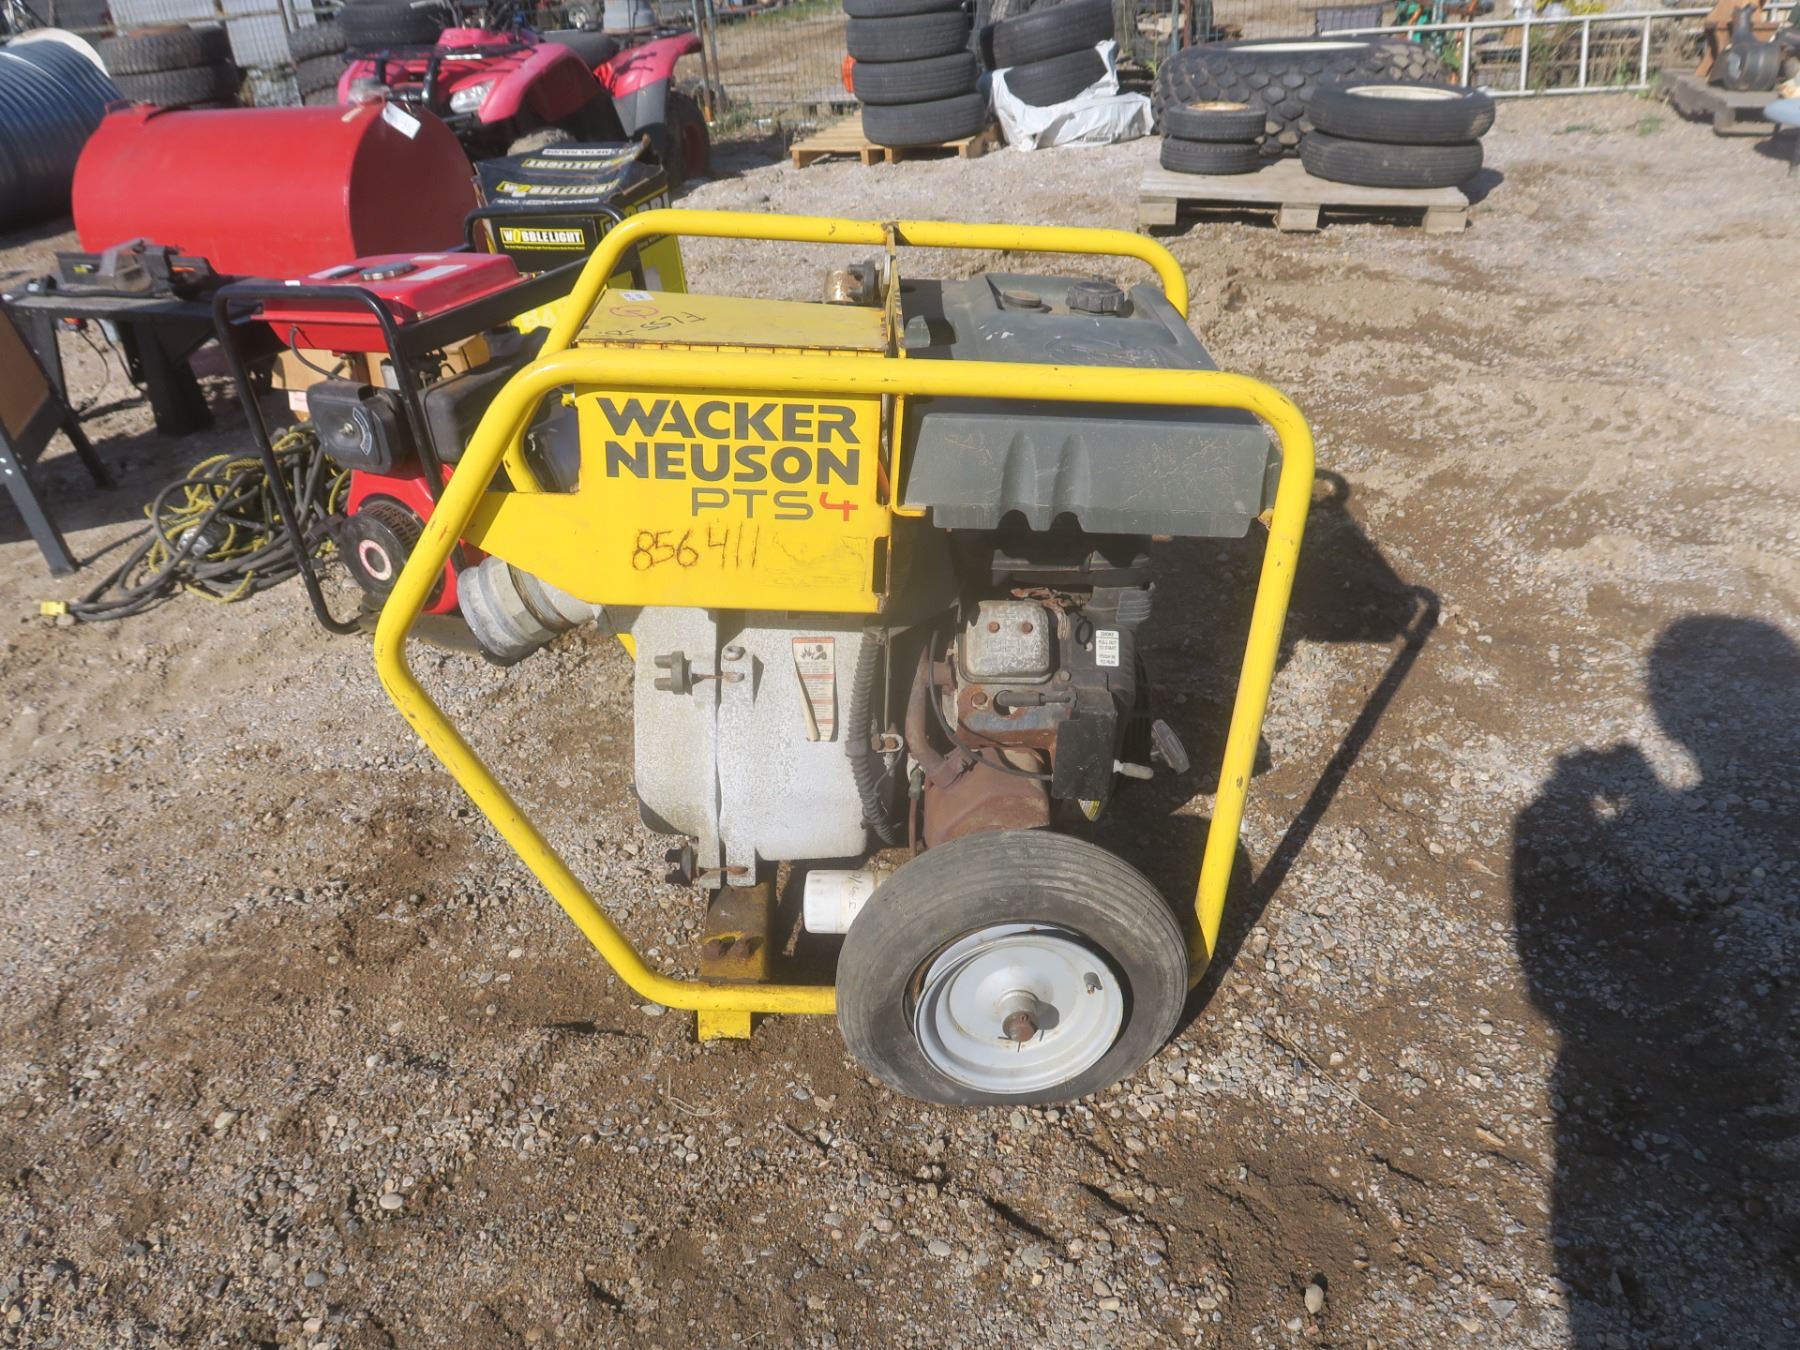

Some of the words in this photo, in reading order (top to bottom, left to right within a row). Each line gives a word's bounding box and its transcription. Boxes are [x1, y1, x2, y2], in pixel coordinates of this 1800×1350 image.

[503, 229, 580, 243] WOBBLELIGHT
[596, 397, 861, 444] WACKER
[605, 441, 860, 485] NEUSON
